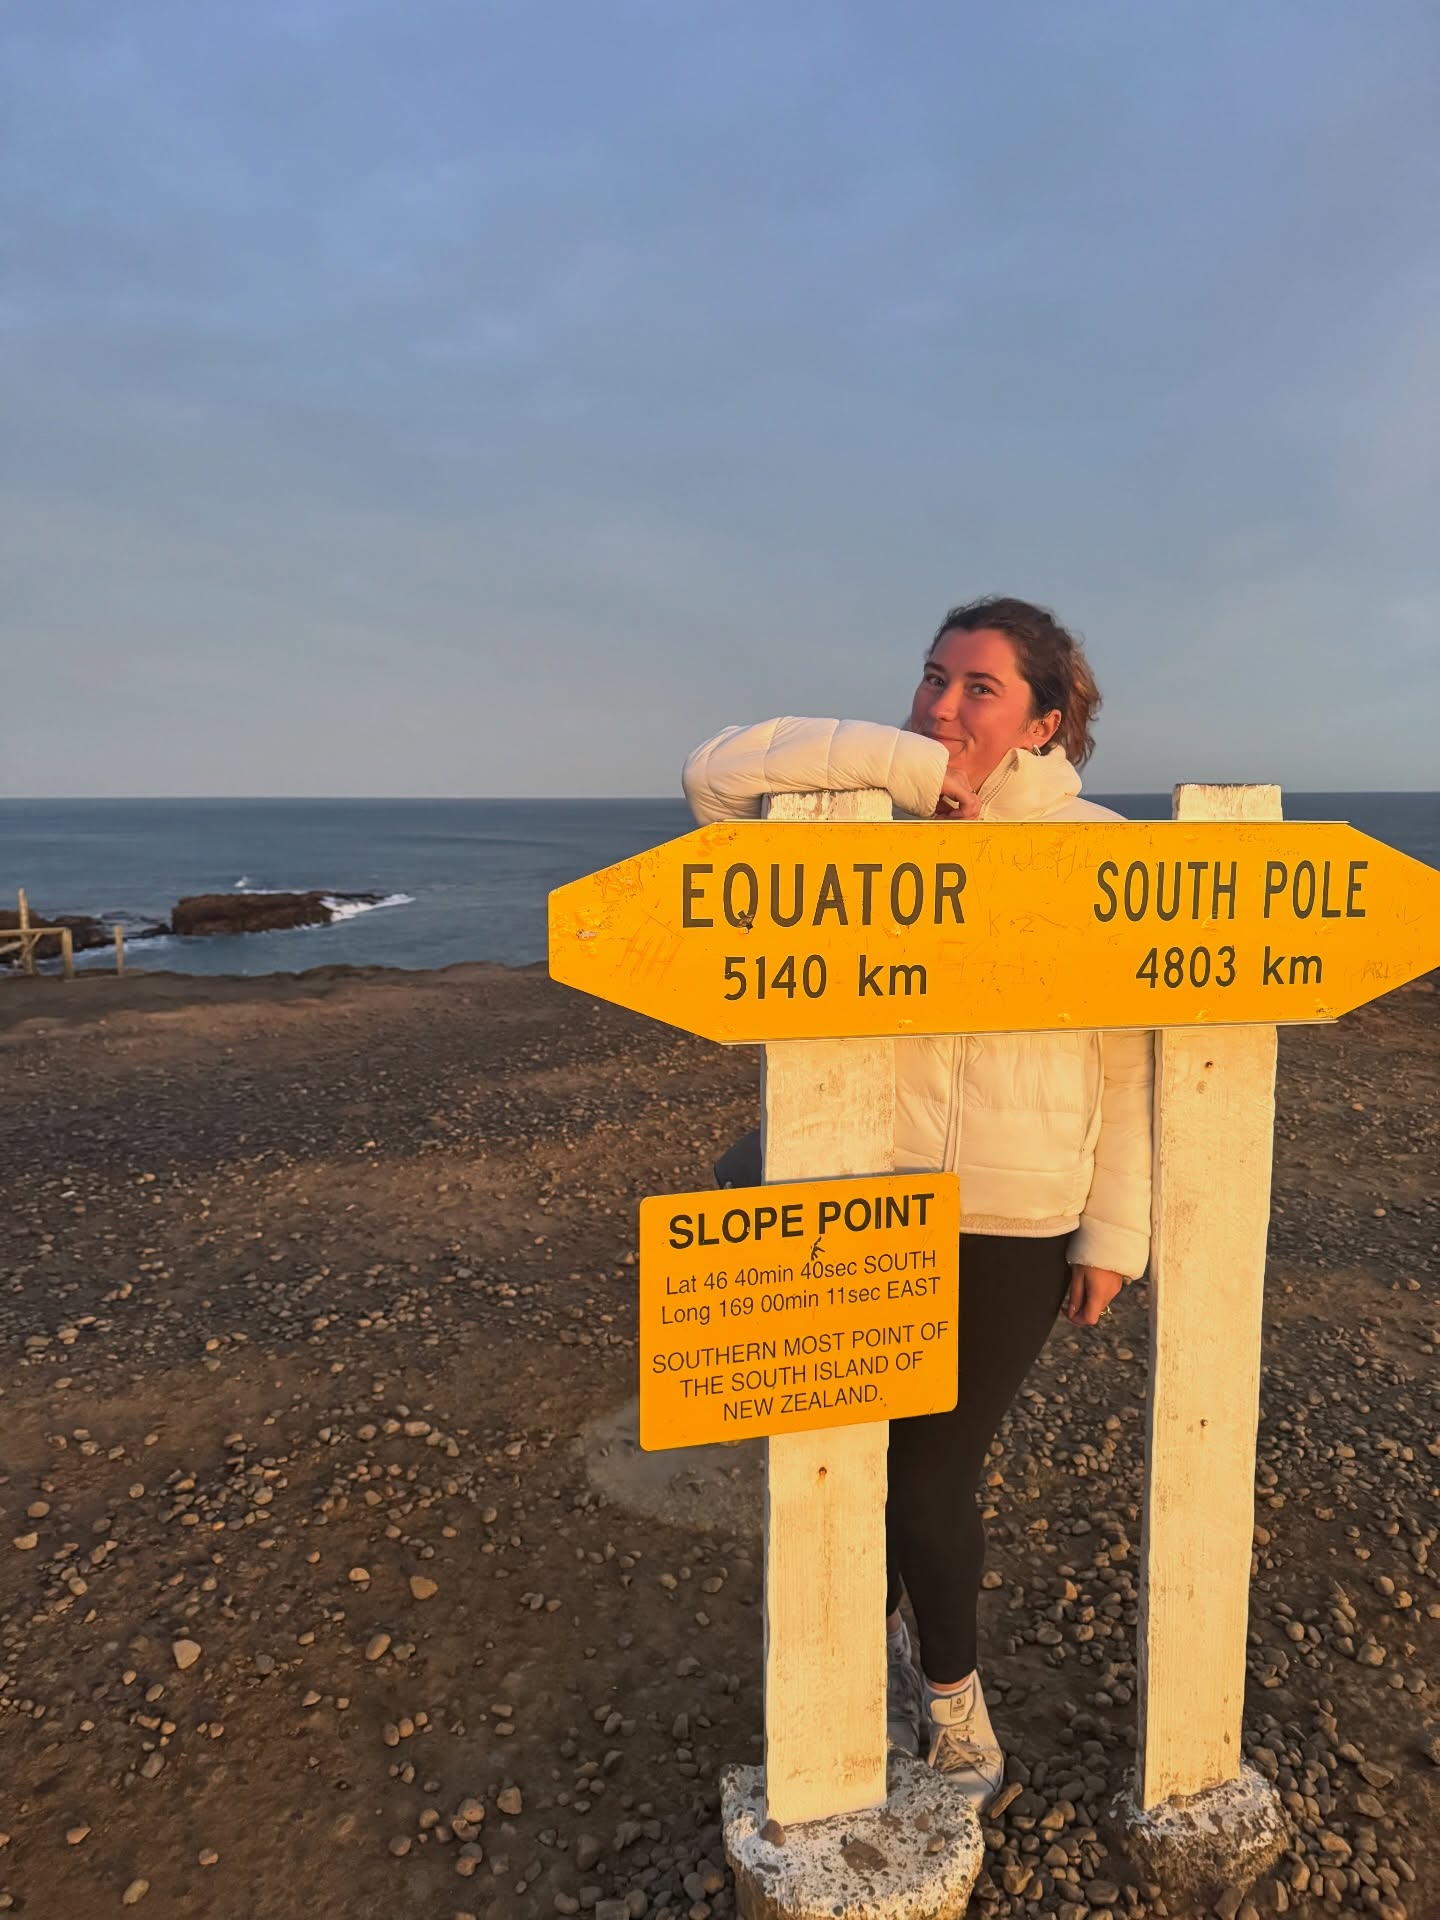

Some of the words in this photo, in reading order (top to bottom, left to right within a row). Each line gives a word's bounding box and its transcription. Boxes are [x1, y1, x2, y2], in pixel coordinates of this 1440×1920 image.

[683, 862, 966, 929] EQUATOR
[1094, 861, 1237, 922] SOUTH
[1264, 860, 1368, 919] POLE
[724, 954, 826, 1000] 5140
[859, 955, 926, 996] km
[1136, 946, 1235, 988] 4803
[1263, 946, 1322, 985] km
[669, 1204, 803, 1249] SLOPE
[819, 1193, 934, 1234] POINT
[667, 1275, 696, 1295] Lat
[704, 1271, 727, 1290] 46
[735, 1265, 793, 1286] 40min
[801, 1261, 856, 1279] 40sec
[864, 1250, 935, 1274] SOUTH
[662, 1306, 709, 1325] Long
[720, 1297, 753, 1317] 169
[761, 1290, 818, 1312] 00min
[828, 1287, 880, 1304] 11sec
[888, 1277, 940, 1299] EAST
[653, 1341, 776, 1373] SOUTHERN
[785, 1333, 844, 1356] MOST
[853, 1325, 914, 1348] POINT
[921, 1321, 948, 1340] OF
[680, 1376, 723, 1397] THE
[732, 1365, 806, 1391] SOUTH
[815, 1356, 888, 1381] ISLAND
[896, 1351, 923, 1370] OF
[724, 1397, 773, 1421] NEW
[781, 1385, 883, 1413] ZEALAND.
